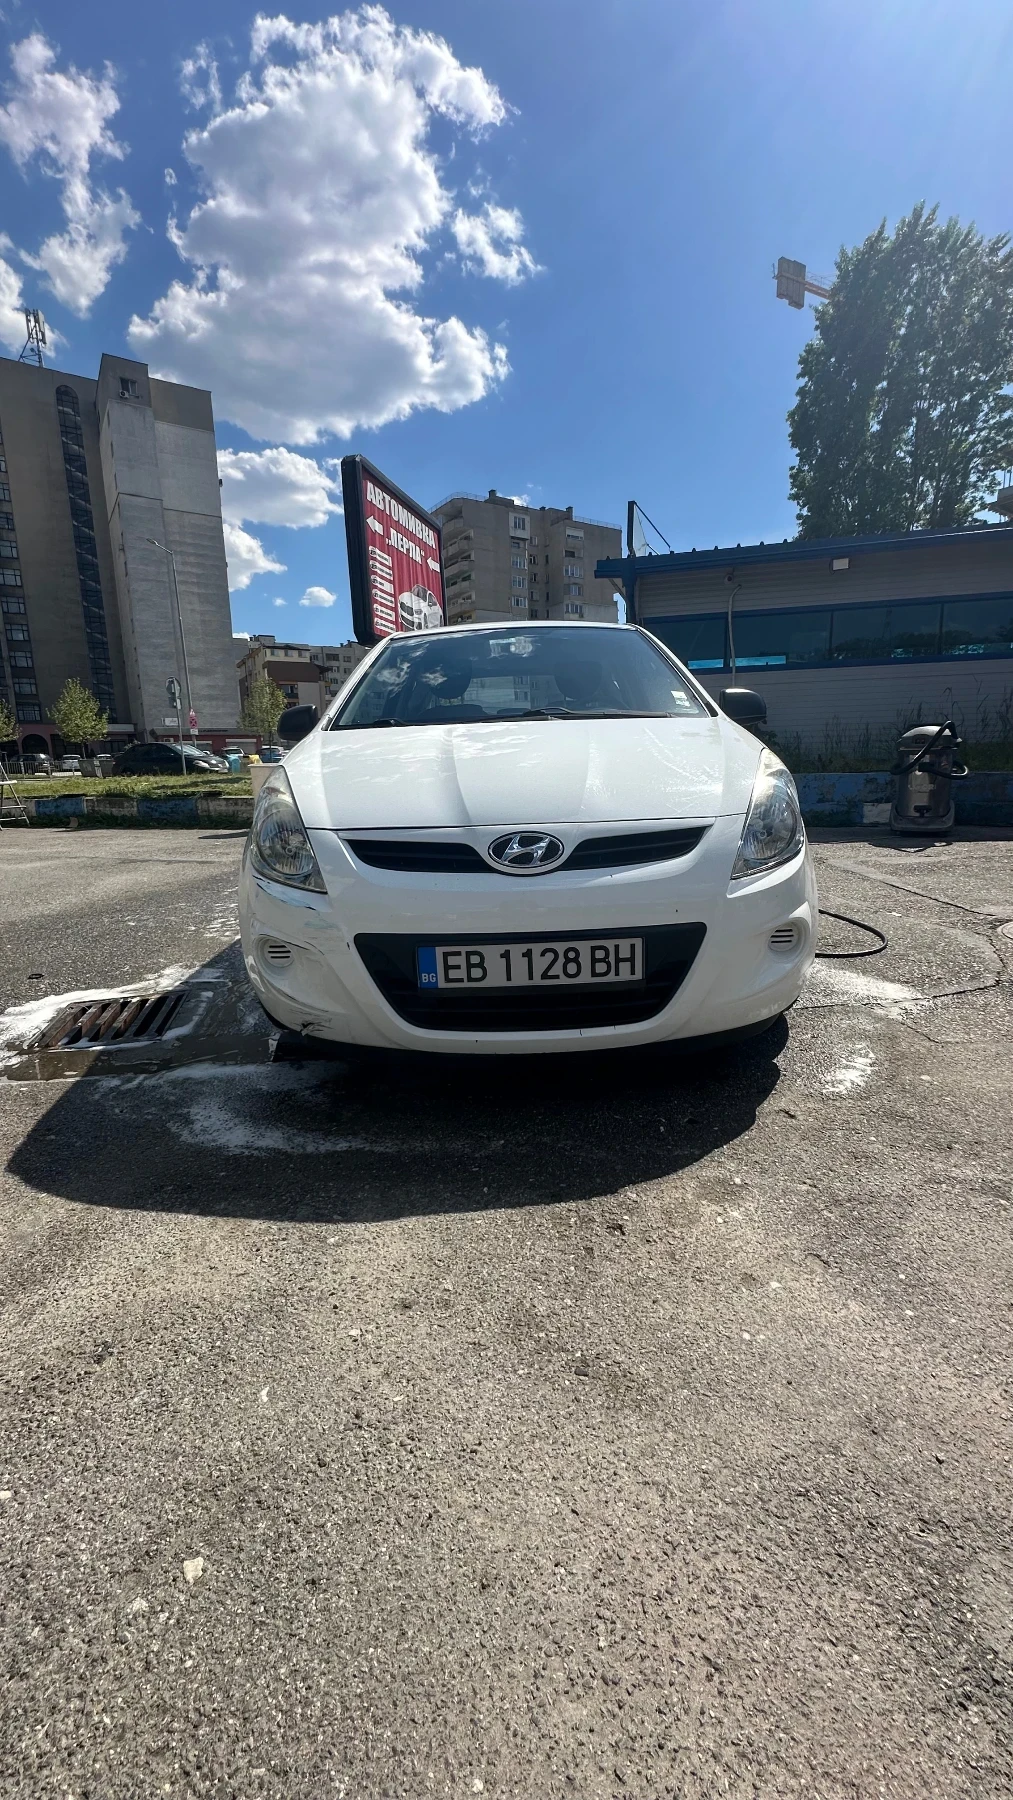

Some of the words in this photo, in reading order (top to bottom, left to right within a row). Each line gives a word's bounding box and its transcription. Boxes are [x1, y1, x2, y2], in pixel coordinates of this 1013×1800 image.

[366, 480, 436, 549] АВТОМИВКА
[421, 973, 437, 983] BG
[442, 950, 488, 983] EB
[500, 947, 582, 982] 1128
[590, 943, 636, 978] BH
